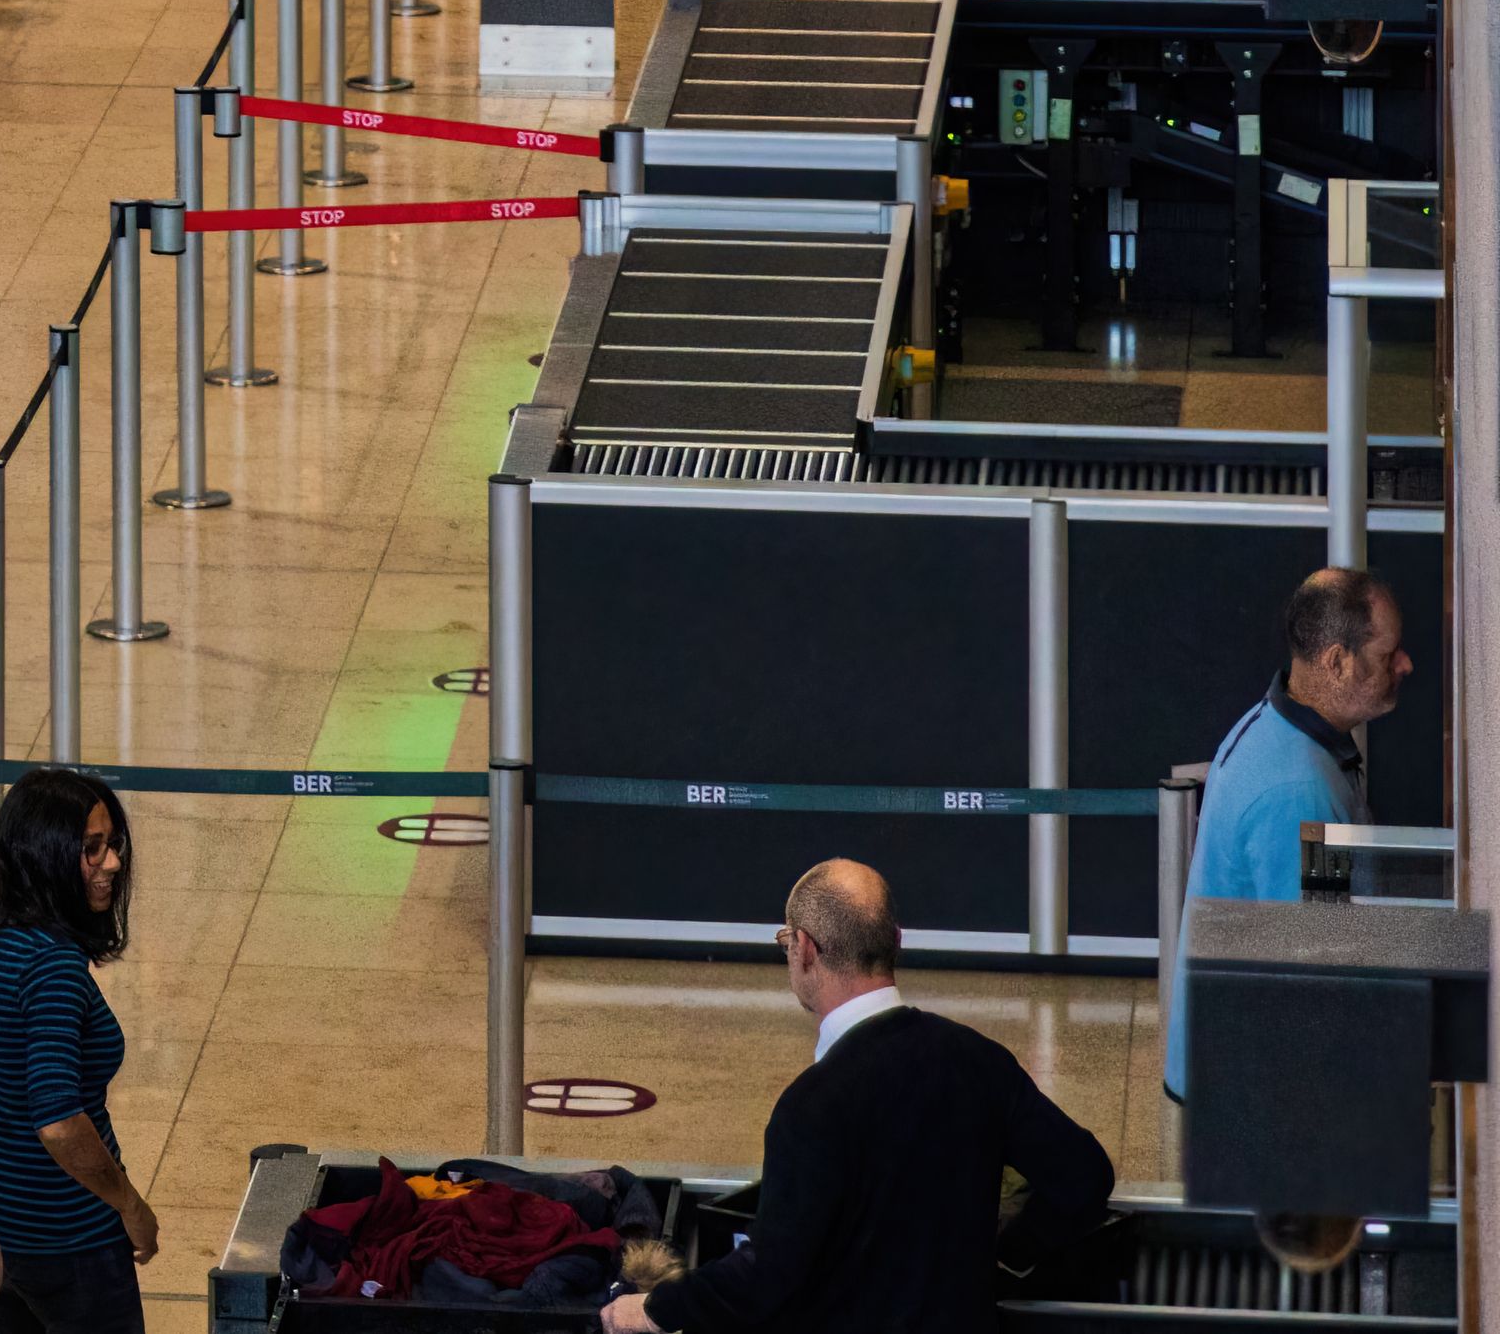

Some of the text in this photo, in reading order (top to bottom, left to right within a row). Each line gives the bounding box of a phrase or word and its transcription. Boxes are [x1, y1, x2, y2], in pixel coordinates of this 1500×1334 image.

[342, 110, 384, 128] STOP
[516, 132, 558, 148] STOP
[300, 210, 345, 225] STOP
[491, 202, 535, 218] STOP
[293, 774, 332, 793] BER
[687, 785, 726, 804] BER
[944, 791, 983, 810] BER
